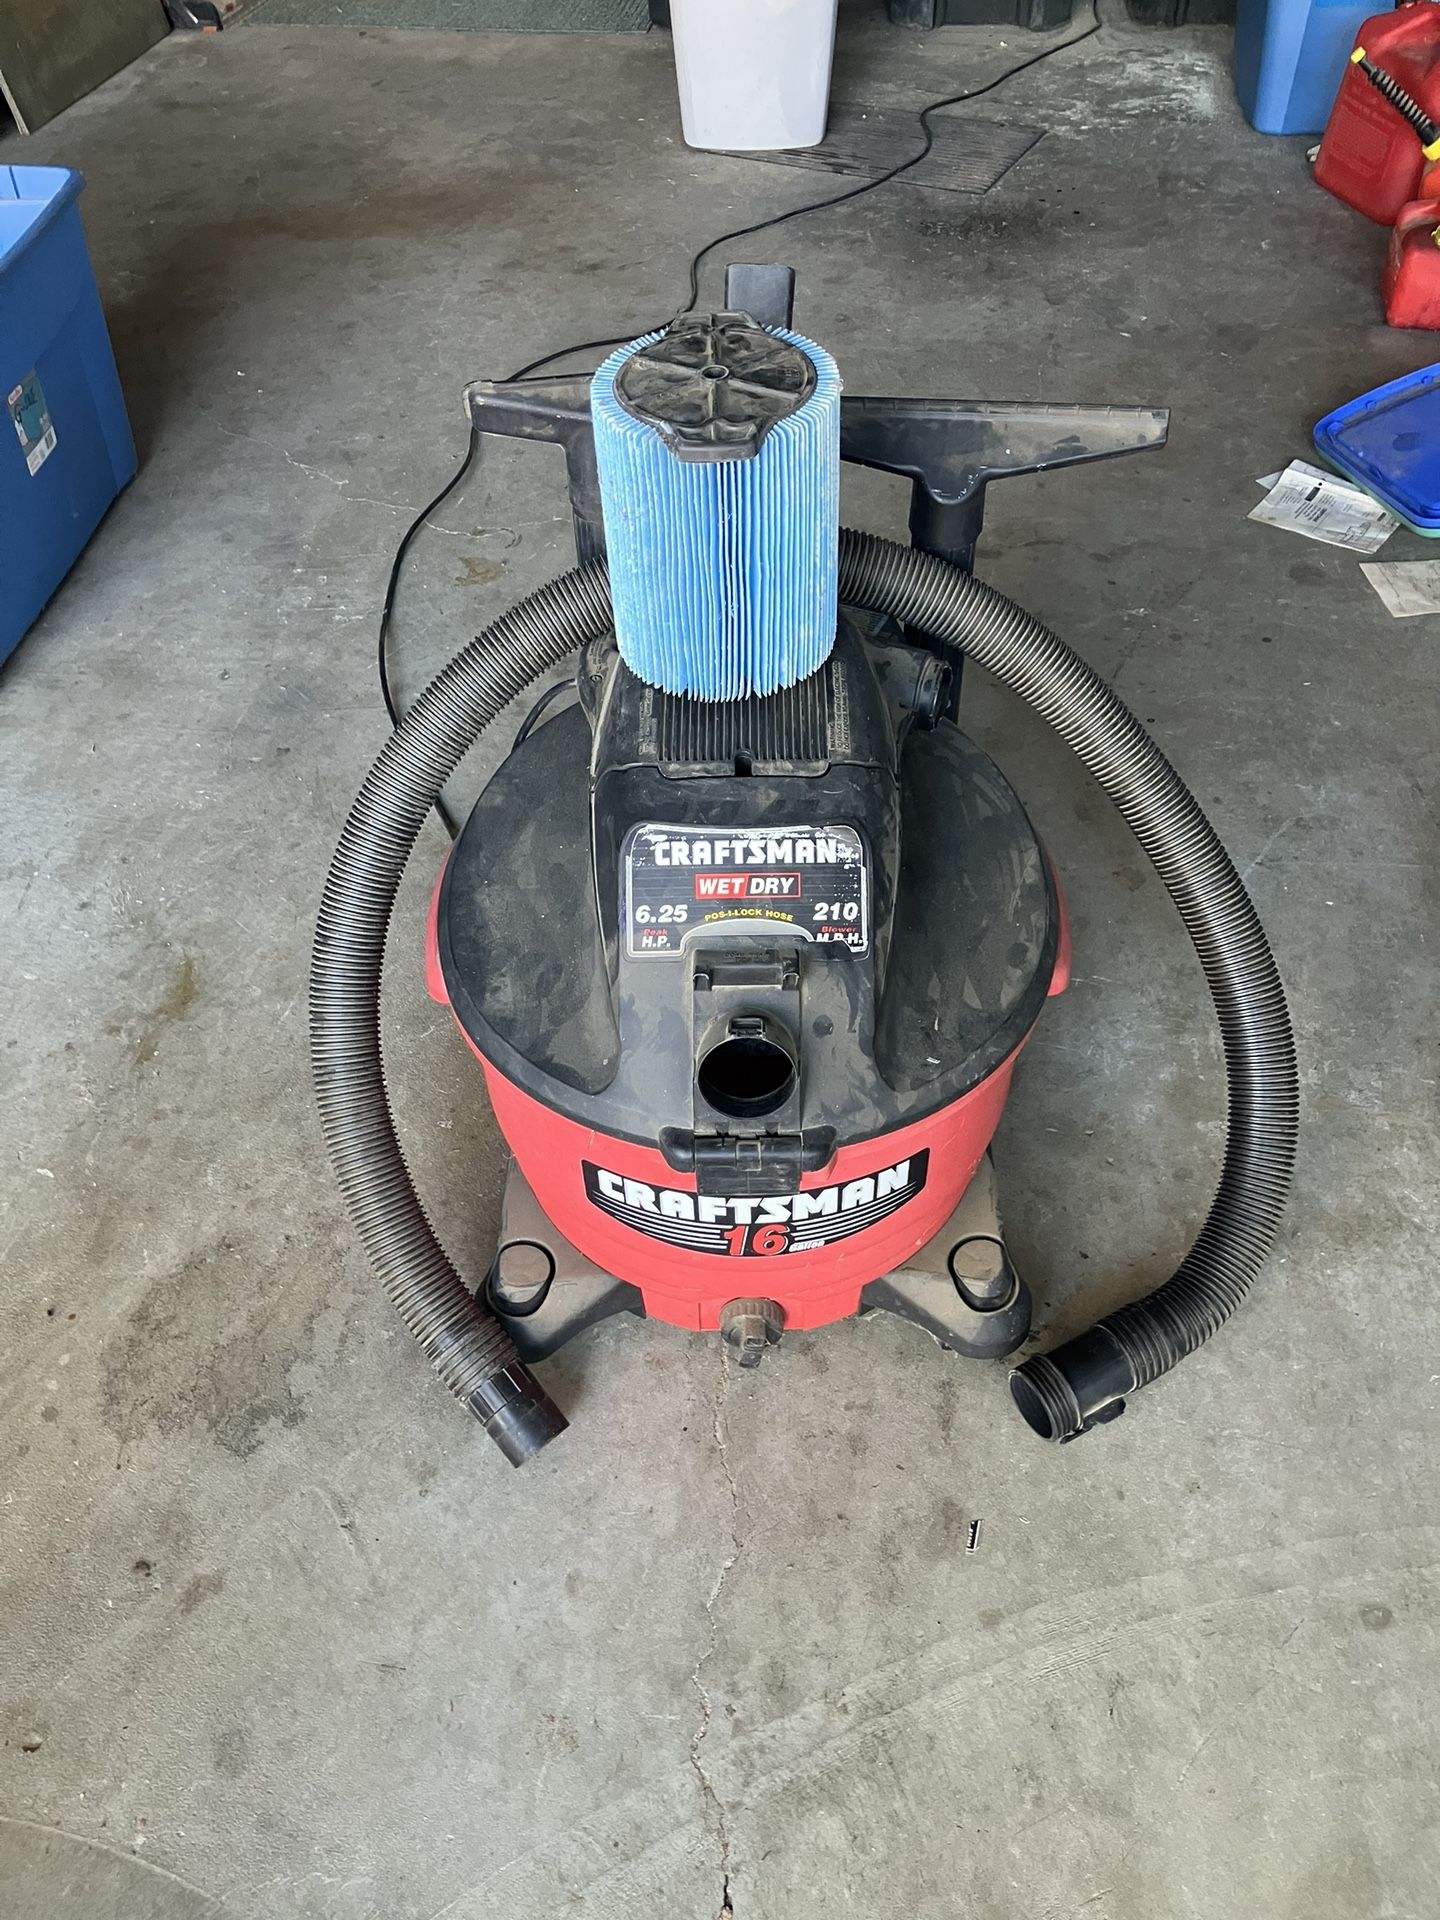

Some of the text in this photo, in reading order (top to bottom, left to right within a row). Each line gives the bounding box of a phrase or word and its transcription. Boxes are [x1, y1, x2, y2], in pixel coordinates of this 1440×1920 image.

[654, 838, 837, 866] CRAFTSMAN
[699, 877, 795, 895] WET DRY
[635, 904, 688, 924] 6.25
[704, 908, 795, 922] POS-I-LOCK HOSE
[812, 902, 859, 921] 210
[821, 925, 858, 933] Blower
[641, 935, 671, 947] H.P.
[816, 933, 863, 944] MPH.
[597, 1159, 911, 1224] CRAFTSMAN
[723, 1223, 791, 1256] 16
